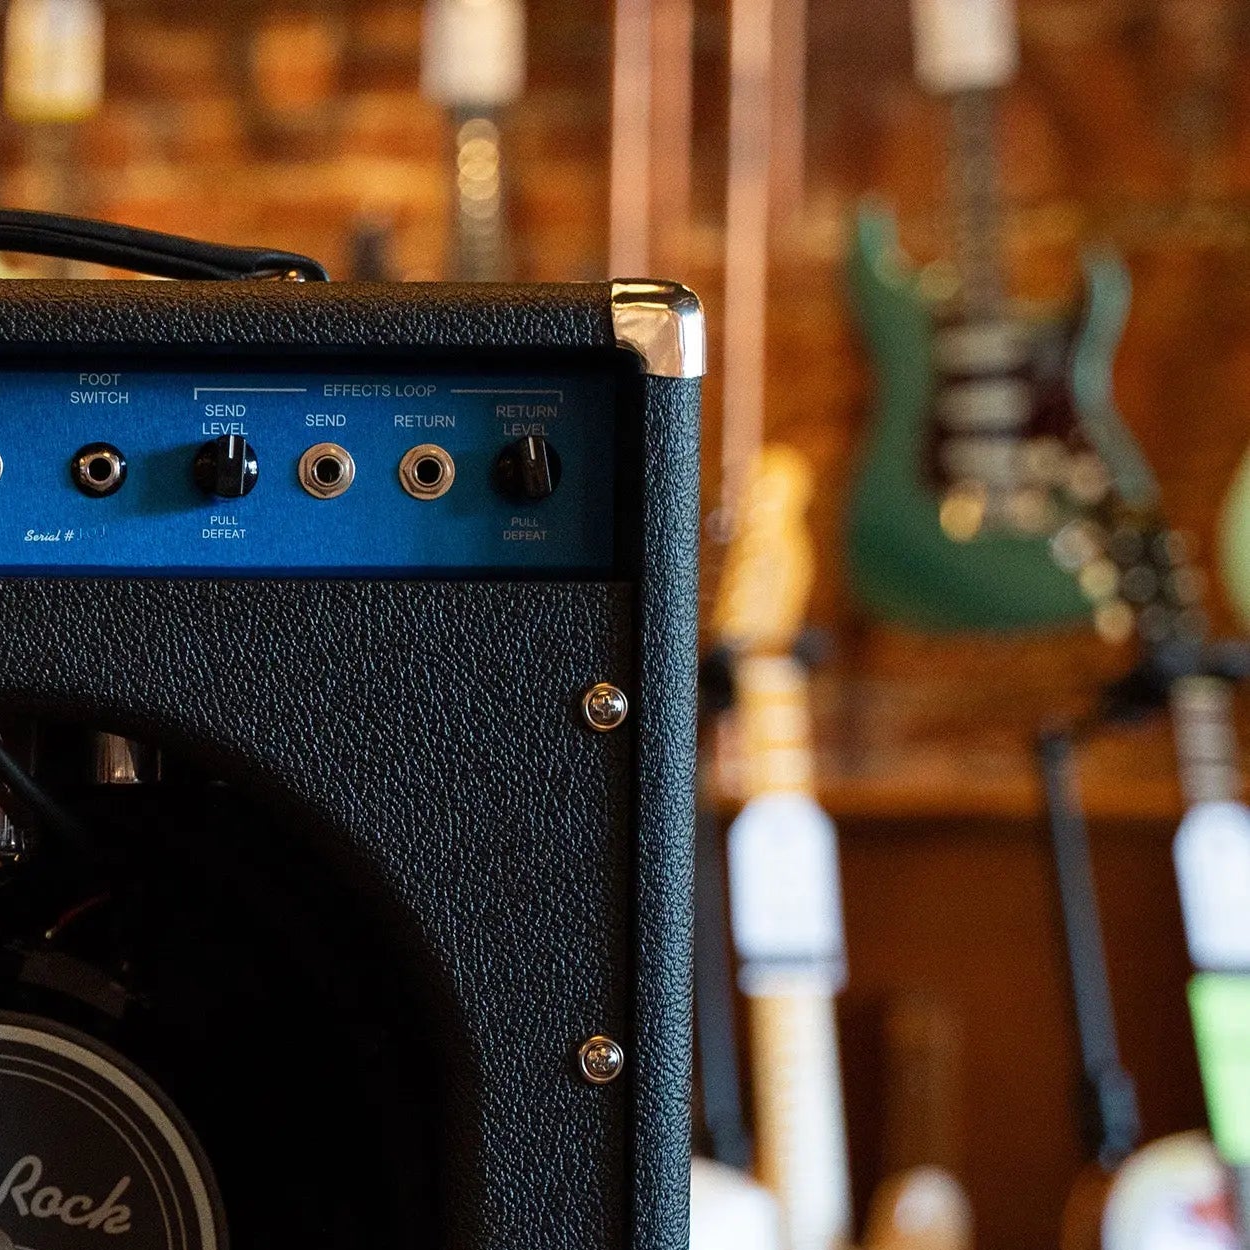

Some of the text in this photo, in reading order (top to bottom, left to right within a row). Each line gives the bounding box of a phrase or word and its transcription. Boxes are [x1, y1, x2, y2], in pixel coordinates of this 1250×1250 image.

[79, 373, 122, 386] FOOT
[323, 384, 437, 397] EFFECTS LOOP
[69, 391, 129, 404] SWITCH
[204, 404, 246, 417] SEND
[495, 405, 558, 418] RETURN
[305, 414, 347, 427] SEND
[394, 415, 456, 428] RETURN
[202, 422, 249, 435] LEVEL
[503, 423, 550, 436] LEVEL
[210, 515, 239, 526] PULL
[511, 517, 539, 527] PULL
[23, 529, 61, 542] Serial
[63, 529, 75, 542] #
[202, 528, 247, 539] DEFEAT
[503, 530, 548, 541] DEFEAT
